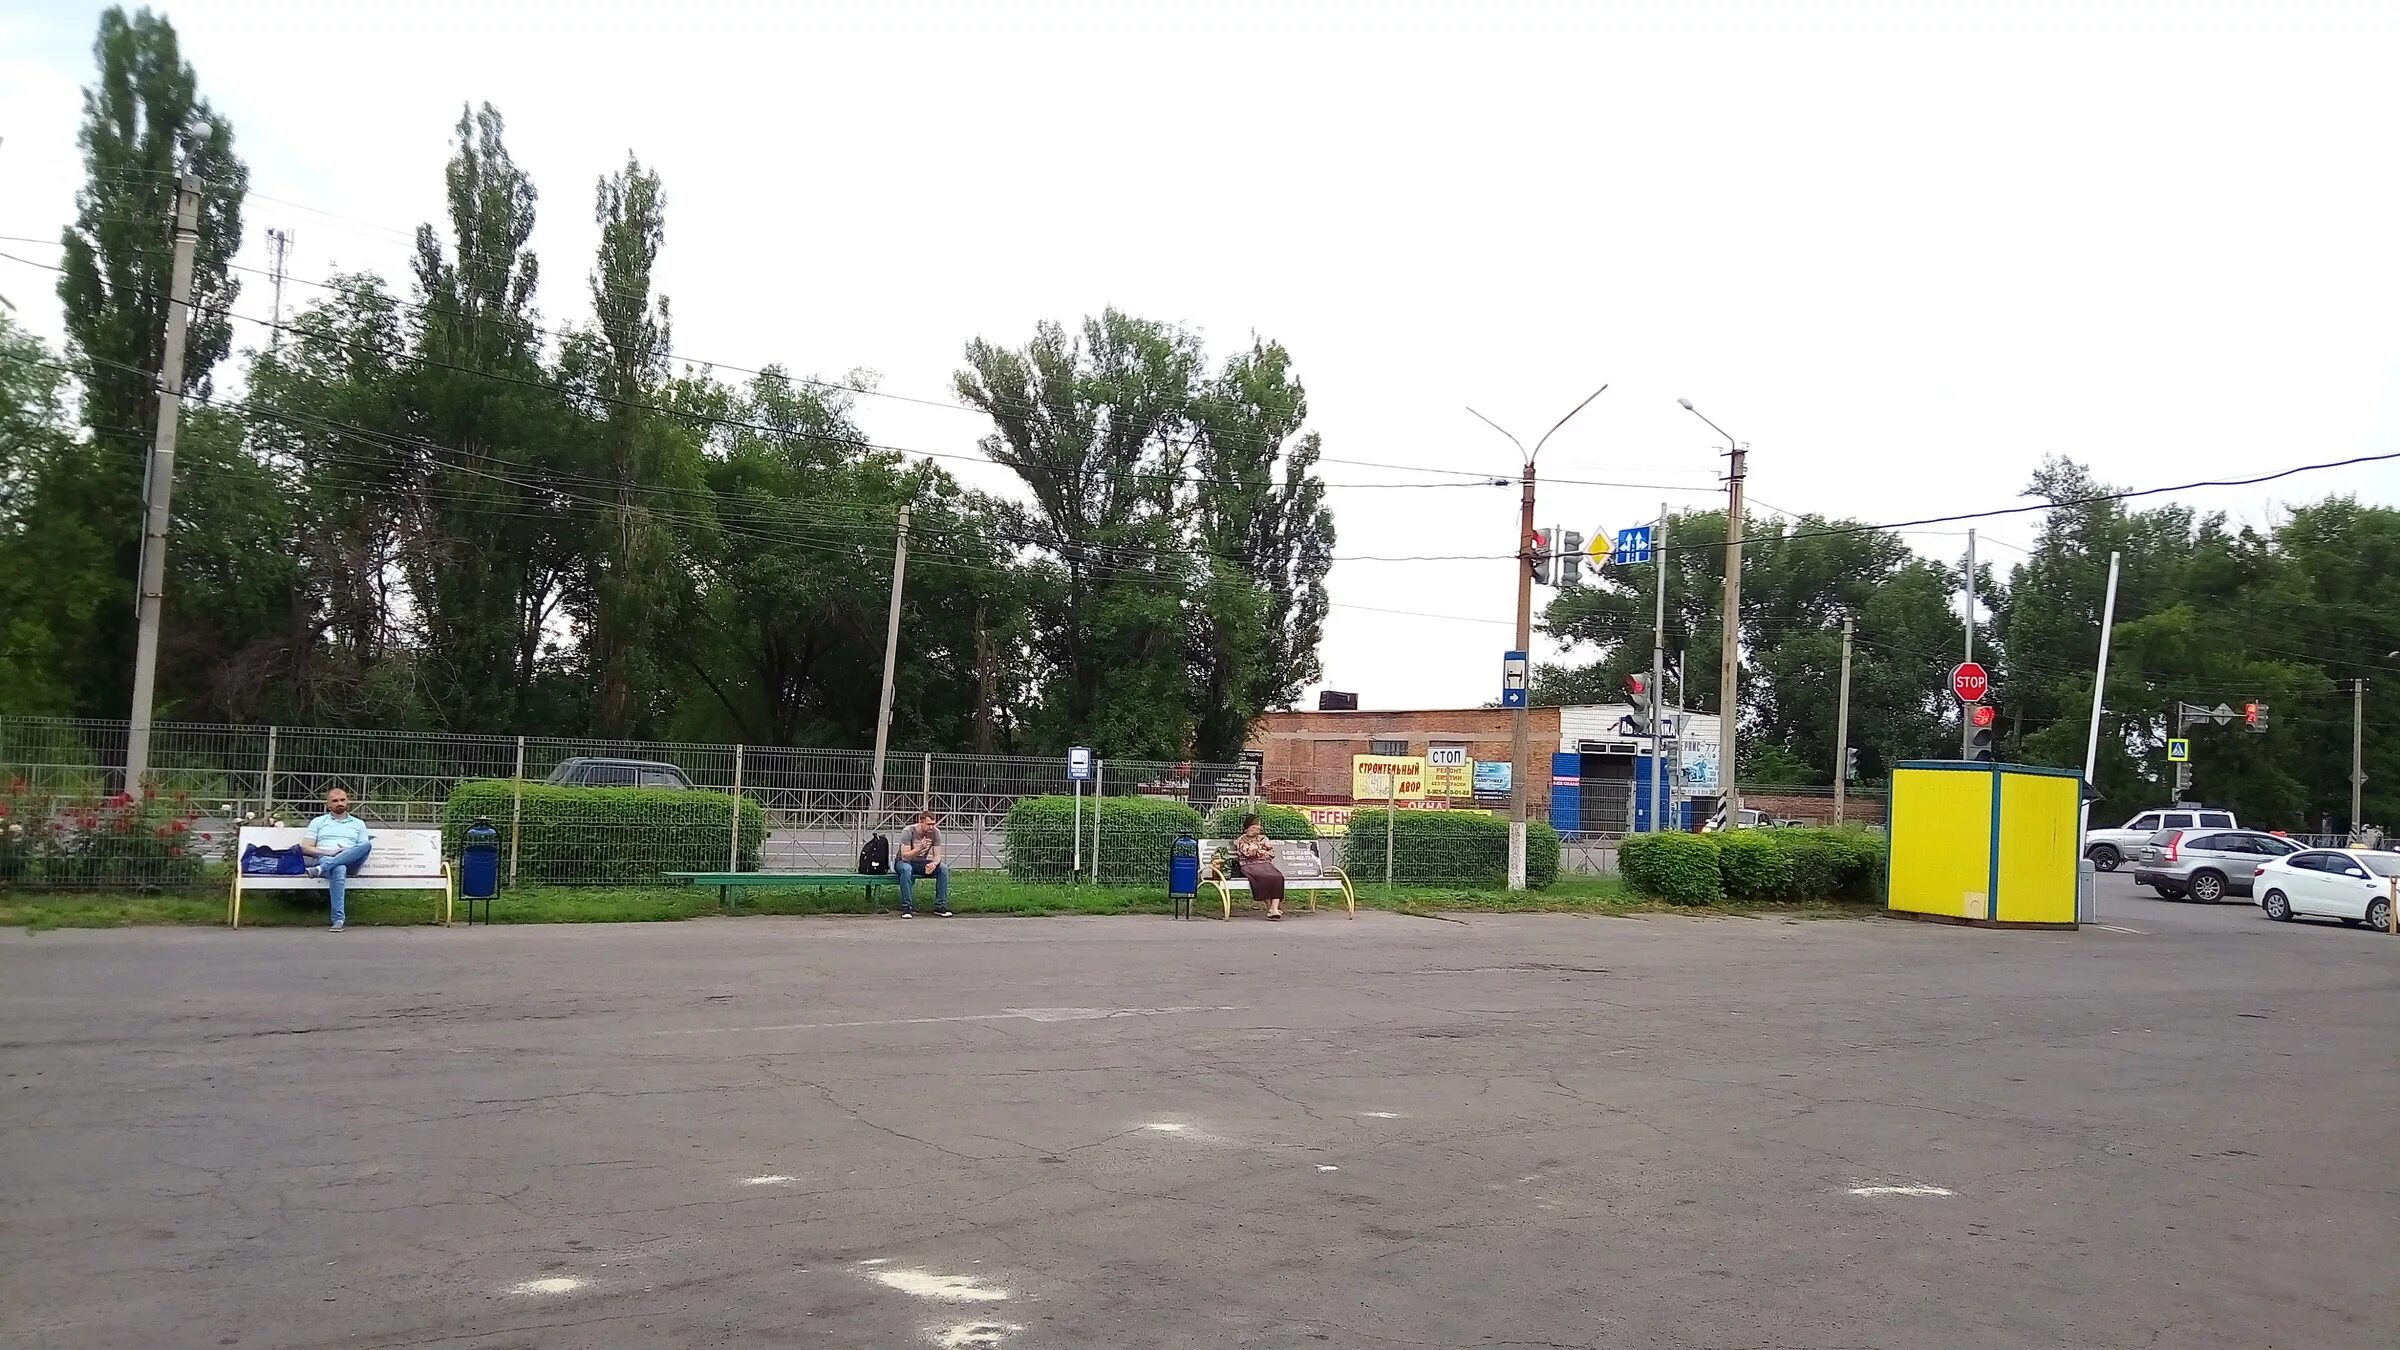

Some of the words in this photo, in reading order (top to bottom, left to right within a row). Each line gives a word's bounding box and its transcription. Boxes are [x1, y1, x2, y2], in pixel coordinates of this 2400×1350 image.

[1956, 675, 1985, 689] STOP
[1432, 750, 1461, 764] СТОП
[1358, 762, 1420, 776] СТРОИТЕЛЬНЫЙ
[1398, 780, 1421, 795] ДВОР
[1407, 801, 1444, 809] ОКНА
